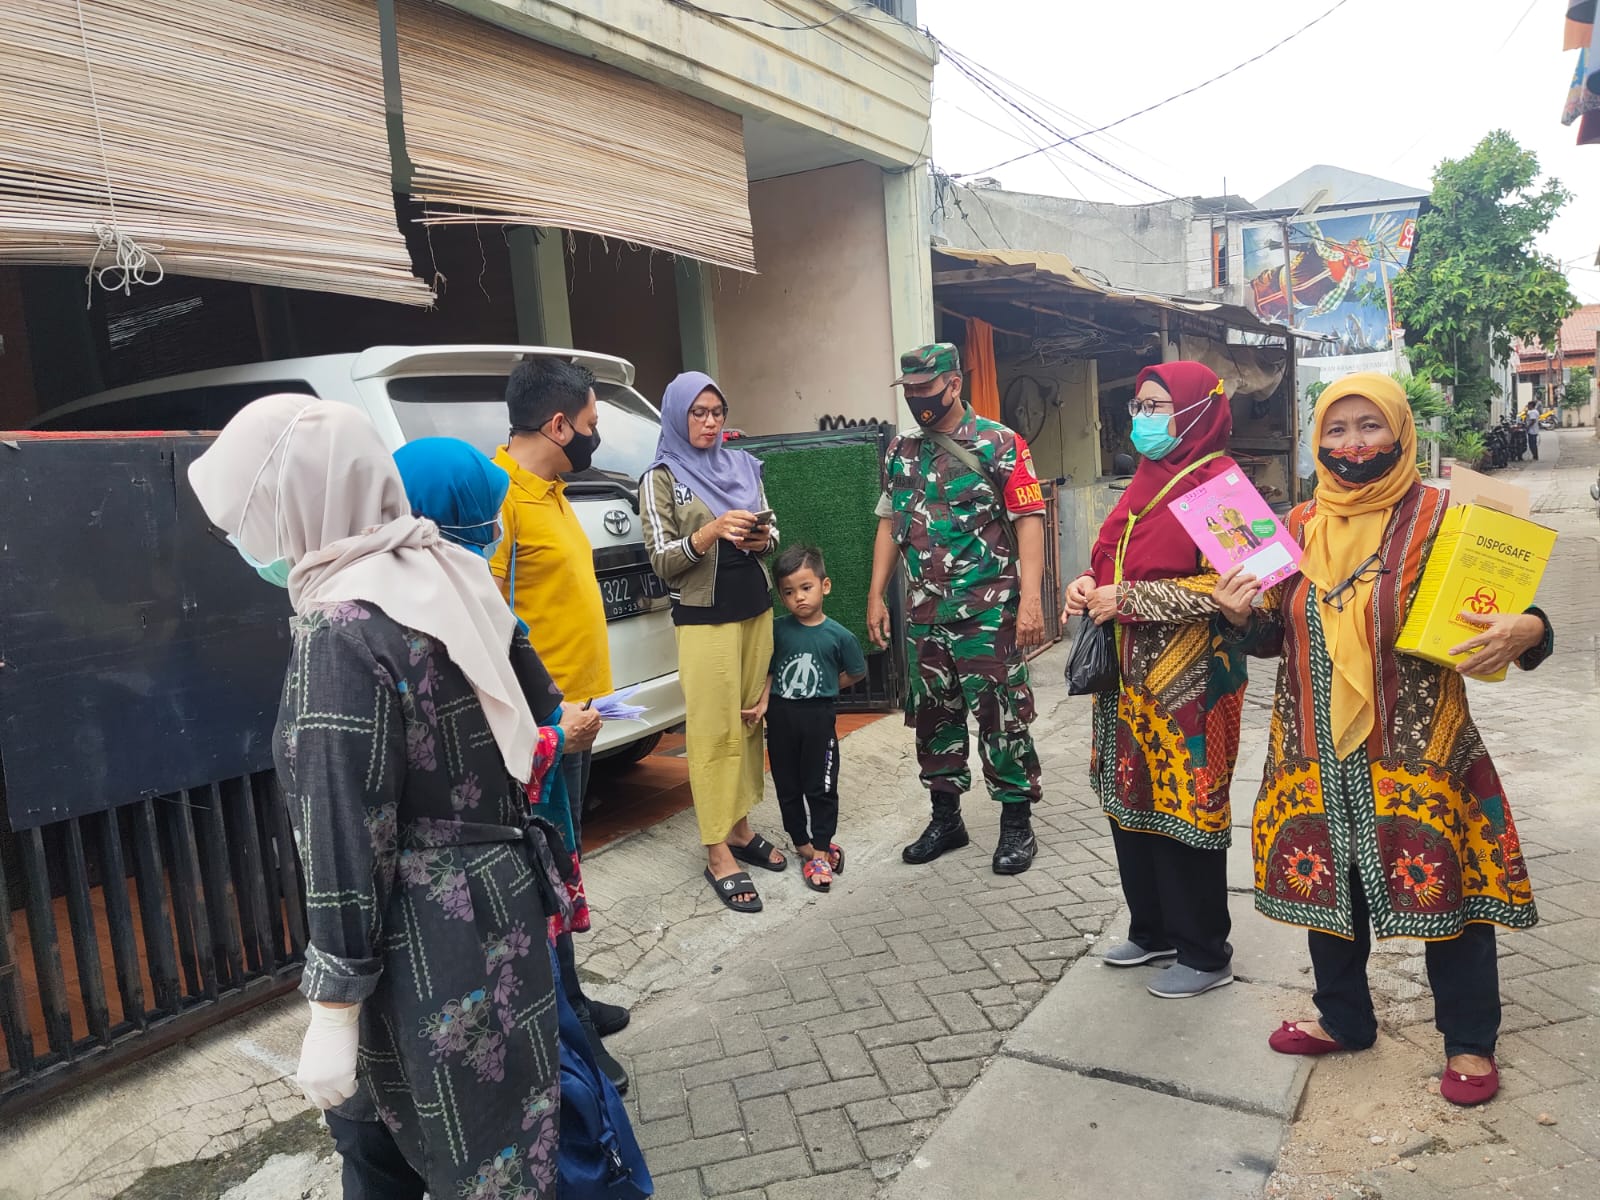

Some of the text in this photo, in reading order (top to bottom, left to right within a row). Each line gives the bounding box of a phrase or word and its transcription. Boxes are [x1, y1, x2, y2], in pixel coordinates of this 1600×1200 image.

[675, 488, 692, 505] 94
[1476, 535, 1531, 562] DISPOSAFE
[600, 578, 631, 603] 322
